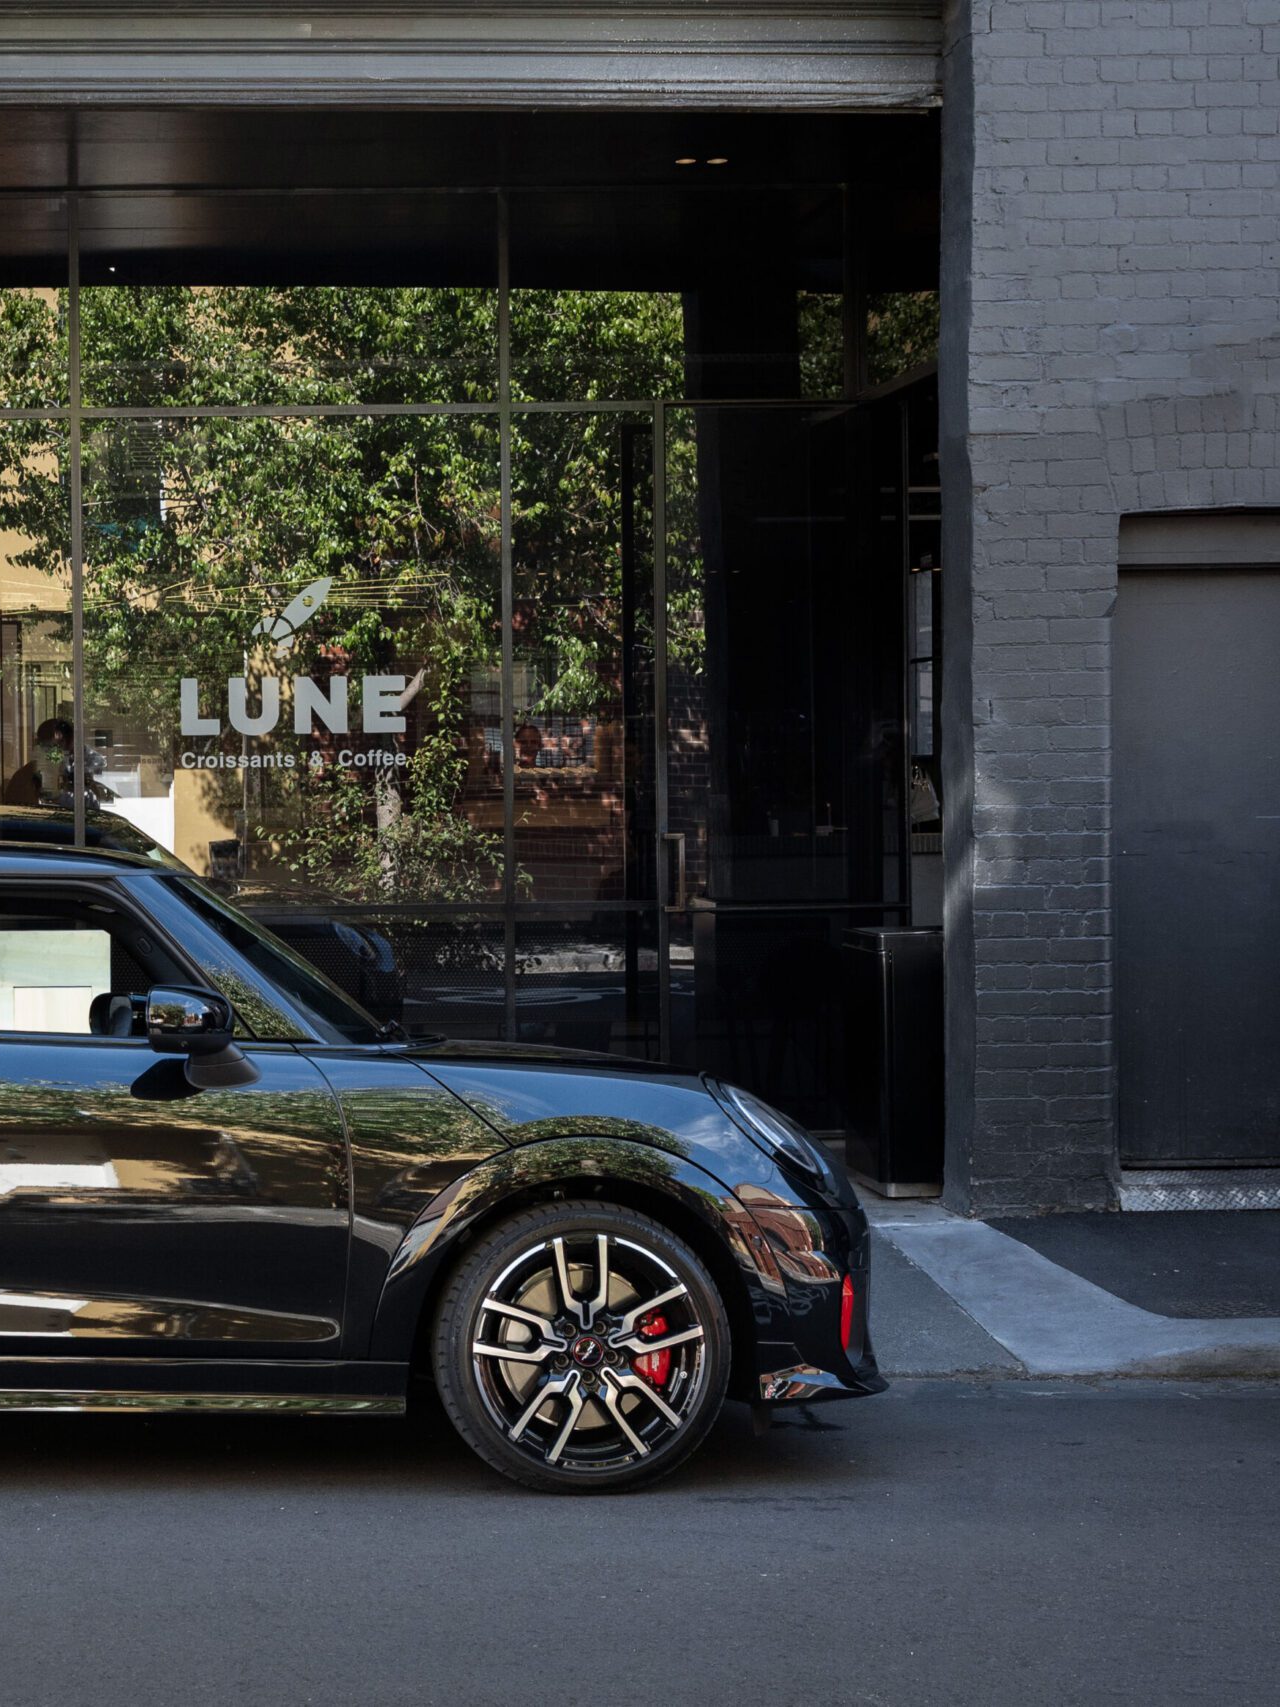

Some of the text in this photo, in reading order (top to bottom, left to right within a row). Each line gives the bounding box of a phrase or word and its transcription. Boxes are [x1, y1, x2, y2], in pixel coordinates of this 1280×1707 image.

[180, 674, 407, 736] LUNE
[180, 749, 407, 769] Croissants & Coffee
